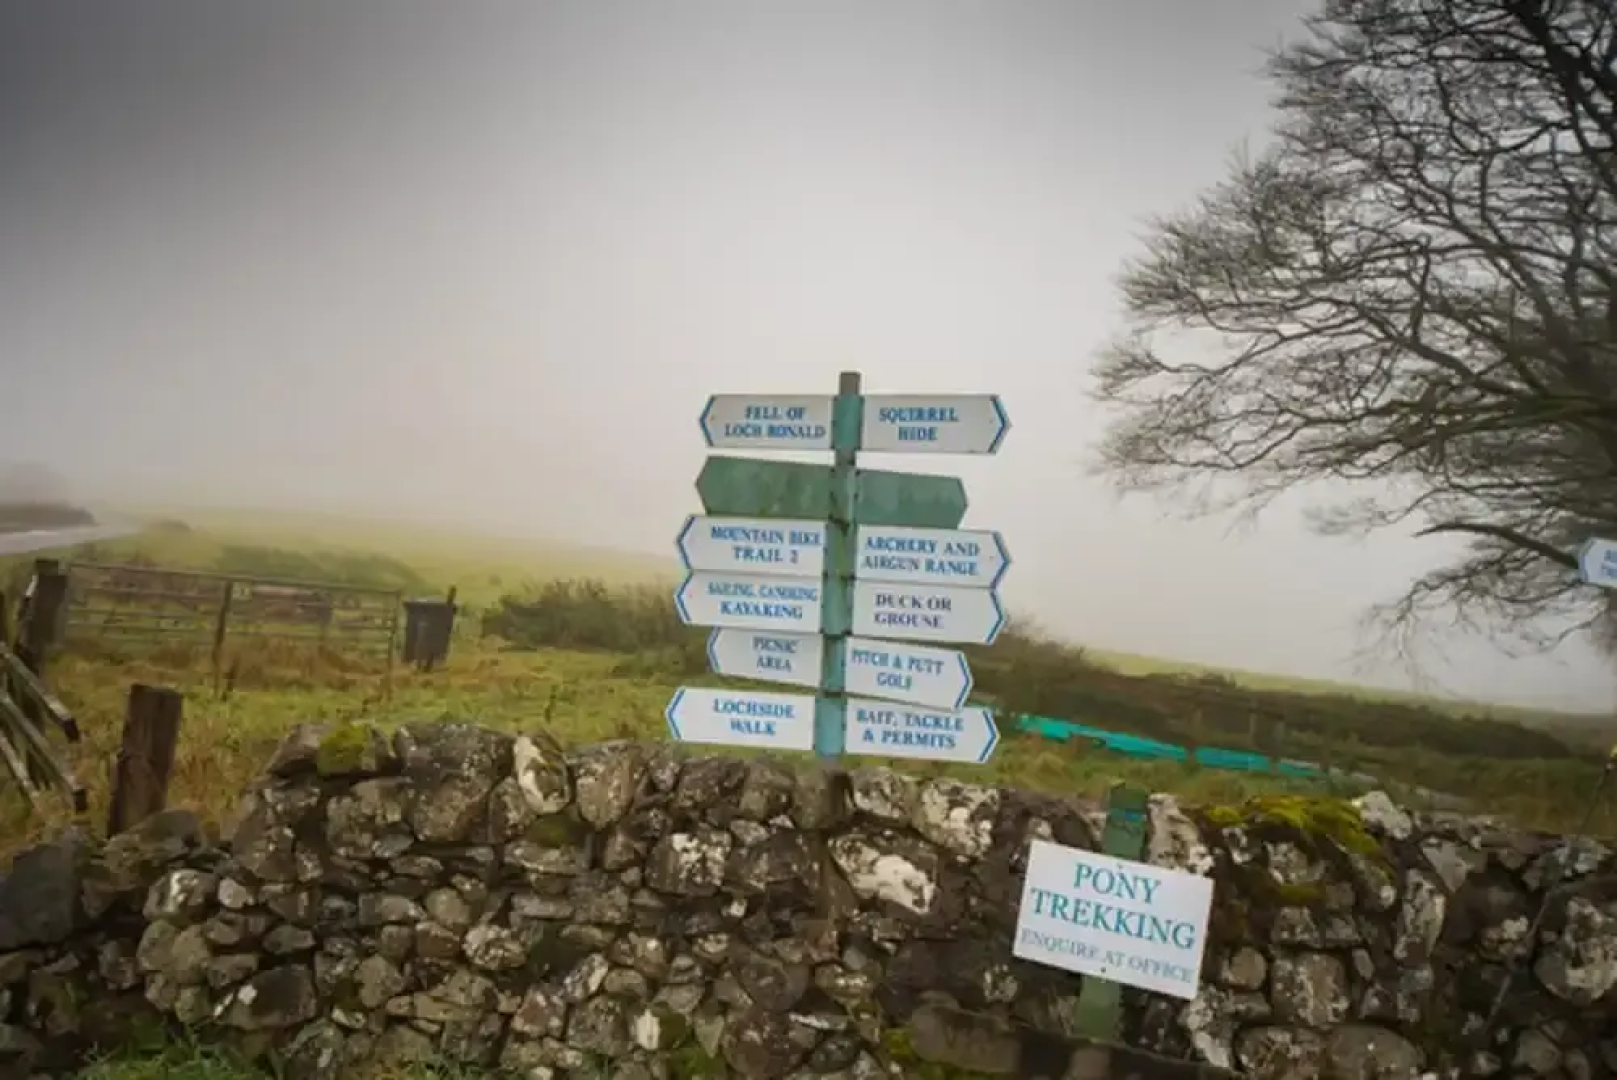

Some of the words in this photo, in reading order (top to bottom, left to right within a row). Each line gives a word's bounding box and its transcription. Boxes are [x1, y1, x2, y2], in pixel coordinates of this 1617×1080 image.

[879, 407, 960, 423] SQUIRREL
[725, 424, 762, 437] LOCH
[898, 426, 938, 440] HIDE
[711, 525, 784, 544] MOUNTAIN
[734, 546, 783, 562] TRAIL
[866, 536, 938, 553] ARCHERY
[944, 542, 979, 556] AND
[862, 556, 920, 570] AIRGUN
[925, 558, 979, 575] RANGE
[720, 601, 802, 619] KAYAKING
[876, 594, 922, 608] DUCK
[927, 597, 952, 610] OR
[757, 656, 792, 672] AREA
[908, 656, 944, 675] PUTT
[877, 672, 912, 690] GOLF
[714, 698, 796, 718] LOCHSIDE
[730, 718, 776, 736] WALK
[905, 713, 964, 732] TACKLE
[881, 730, 956, 748] PERMITS
[1074, 862, 1162, 904] PONY
[1030, 887, 1196, 950] TREKKING
[1022, 928, 1100, 958] ENQUIRE
[1102, 950, 1128, 968] AT
[1128, 954, 1192, 983] OFFICE
